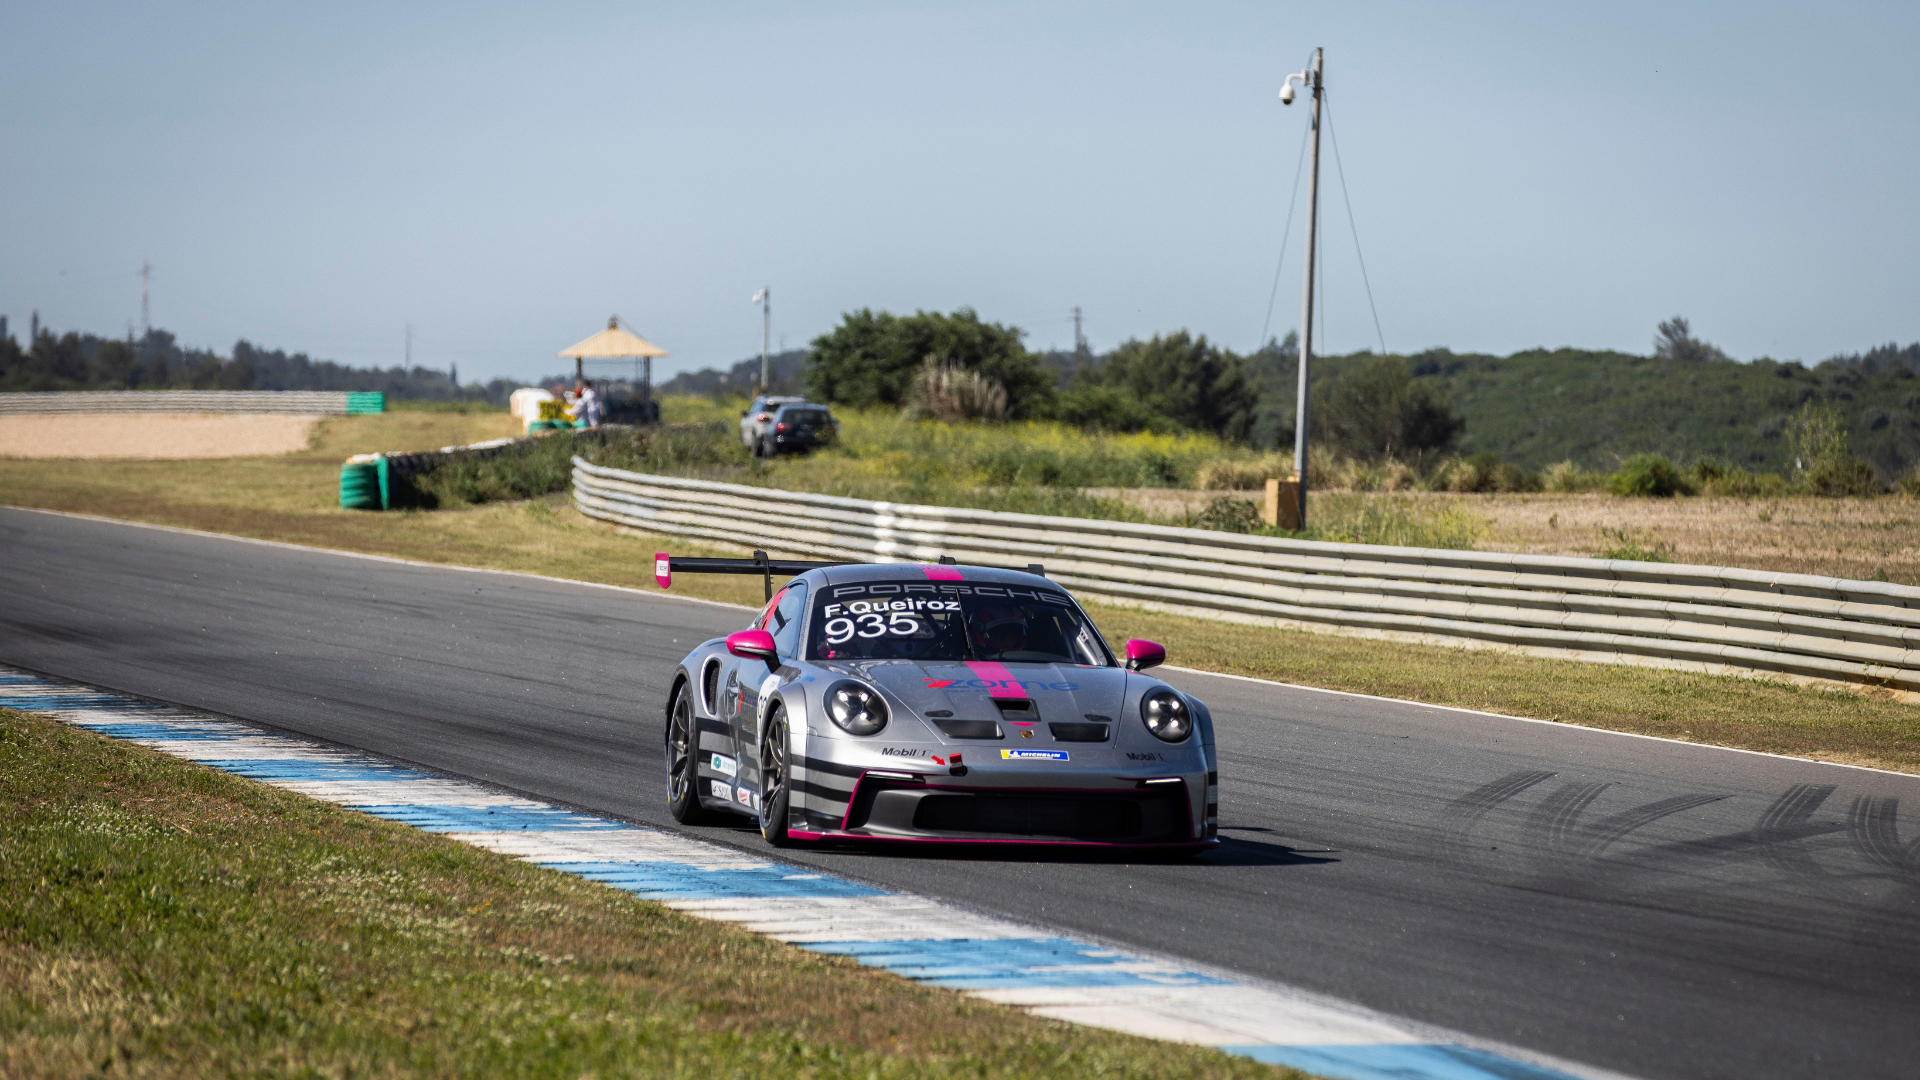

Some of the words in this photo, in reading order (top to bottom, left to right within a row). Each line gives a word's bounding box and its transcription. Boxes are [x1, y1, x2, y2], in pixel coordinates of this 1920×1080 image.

[833, 584, 1071, 607] PORSCHE
[824, 598, 960, 618] F.Queiroz
[824, 611, 919, 645] 935
[881, 747, 917, 757] Mobil
[1125, 752, 1157, 761] Mobil
